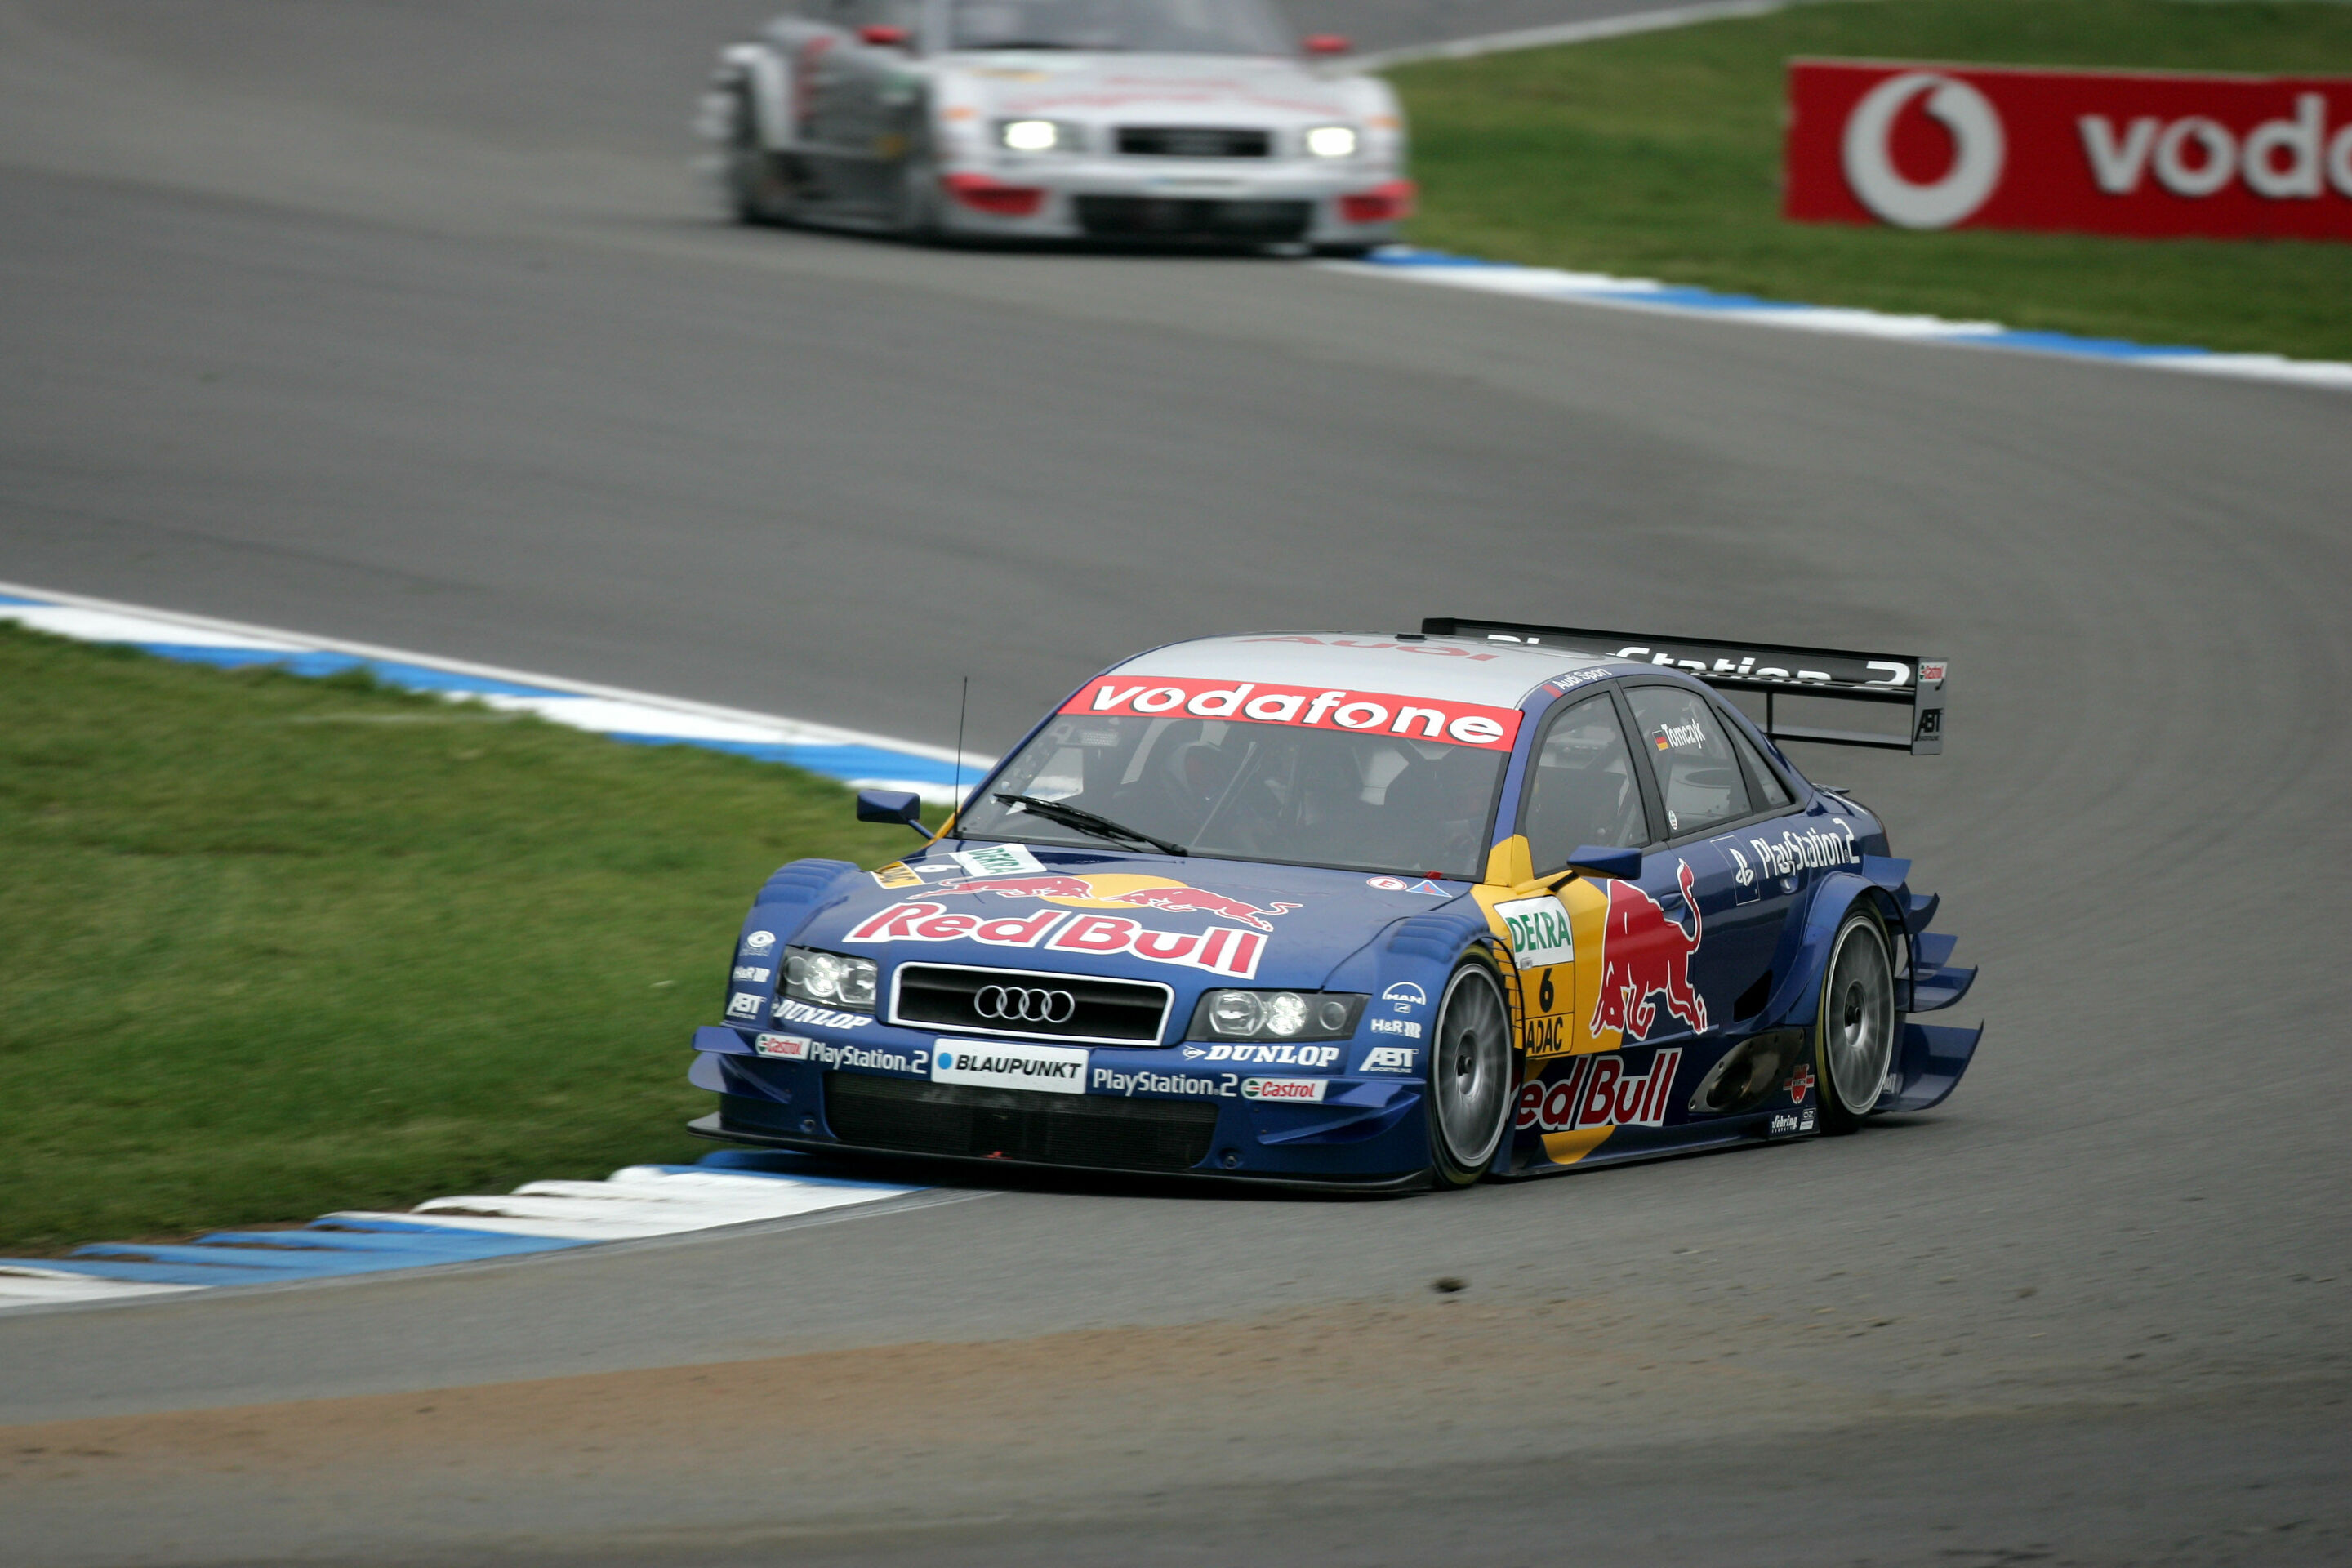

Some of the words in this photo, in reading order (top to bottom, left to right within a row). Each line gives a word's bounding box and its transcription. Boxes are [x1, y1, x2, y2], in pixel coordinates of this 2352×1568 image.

[2077, 92, 2352, 198] vod
[1234, 635, 1500, 662] Audi
[1552, 674, 1583, 690] Audi
[1573, 668, 1612, 681] Sport
[1090, 684, 1504, 744] vodafone
[1914, 708, 1941, 741] ABT
[1661, 718, 1706, 749] Tomczyk
[967, 847, 1025, 875] DEKRA
[1750, 826, 1846, 879] PlayStation
[1833, 818, 1860, 864] 2
[843, 902, 1065, 948] Red
[1045, 913, 1269, 980] Bull
[1505, 909, 1572, 953] DEKRA
[1386, 993, 1423, 1005] MAN
[1539, 968, 1555, 1013] 6
[773, 999, 873, 1029] DUNLOP
[1371, 1018, 1404, 1034] H&R
[767, 1037, 802, 1056] Castrol
[1525, 1016, 1564, 1054] ADAC
[810, 1041, 906, 1071] PlayStation
[911, 1049, 929, 1074] 2
[955, 1054, 1082, 1080] BLAUPUNKT
[1204, 1045, 1340, 1067] DUNLOP
[1359, 1046, 1414, 1071] ABT
[1093, 1068, 1214, 1097] PlayStation
[1219, 1073, 1238, 1098] 2
[1262, 1080, 1316, 1099] Castrol
[1512, 1054, 1593, 1130] ed
[1575, 1047, 1682, 1128] Bull
